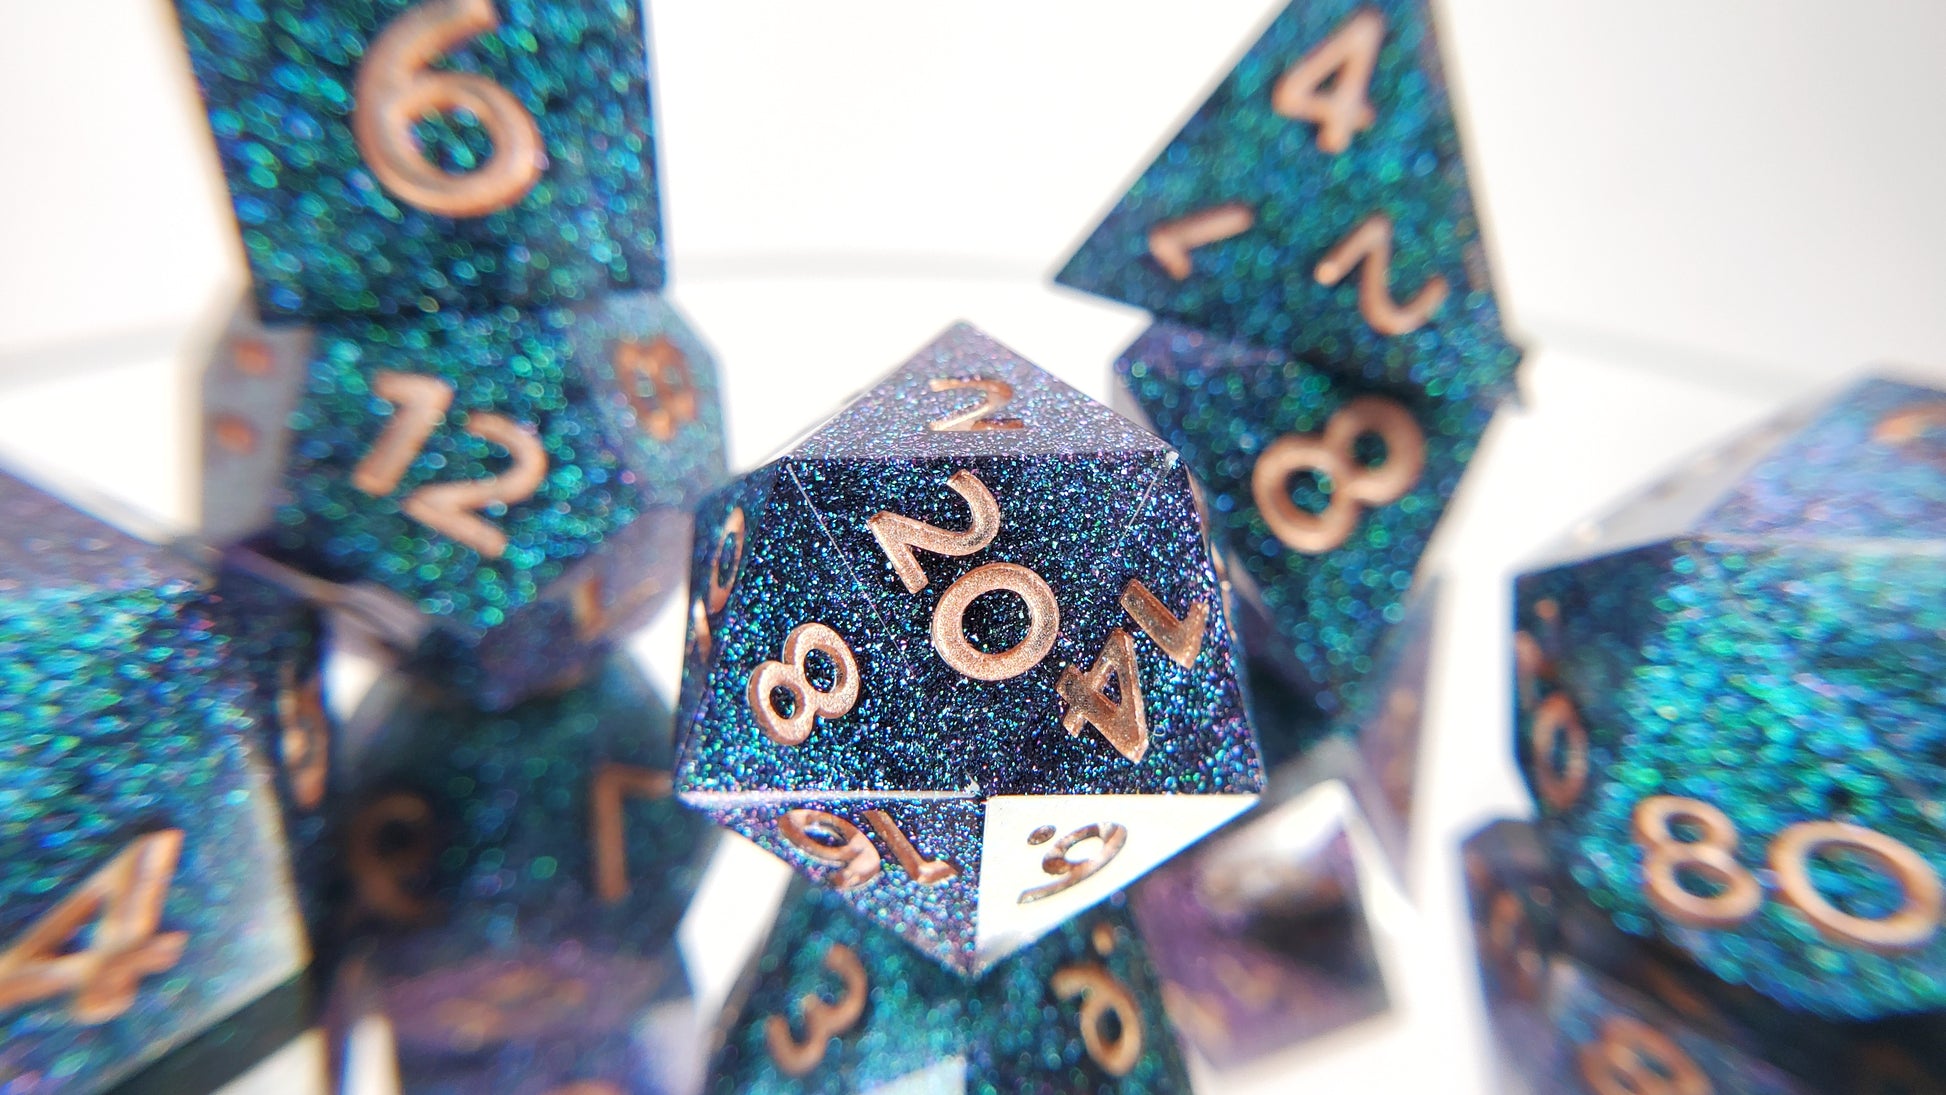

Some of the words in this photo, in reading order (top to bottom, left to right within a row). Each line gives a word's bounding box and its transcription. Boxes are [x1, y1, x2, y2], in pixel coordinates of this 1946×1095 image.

[355, 0, 547, 217] 6
[1272, 8, 1386, 154] 4
[1313, 214, 1449, 336] 2
[352, 370, 547, 558] 12
[930, 377, 1025, 432] 2
[1251, 398, 1427, 554] 8
[867, 469, 1060, 681] 20
[748, 622, 862, 746] 8
[1056, 578, 1210, 763] 14
[0, 828, 188, 1024] 4
[778, 809, 957, 890] 16
[1632, 794, 1942, 950] 80
